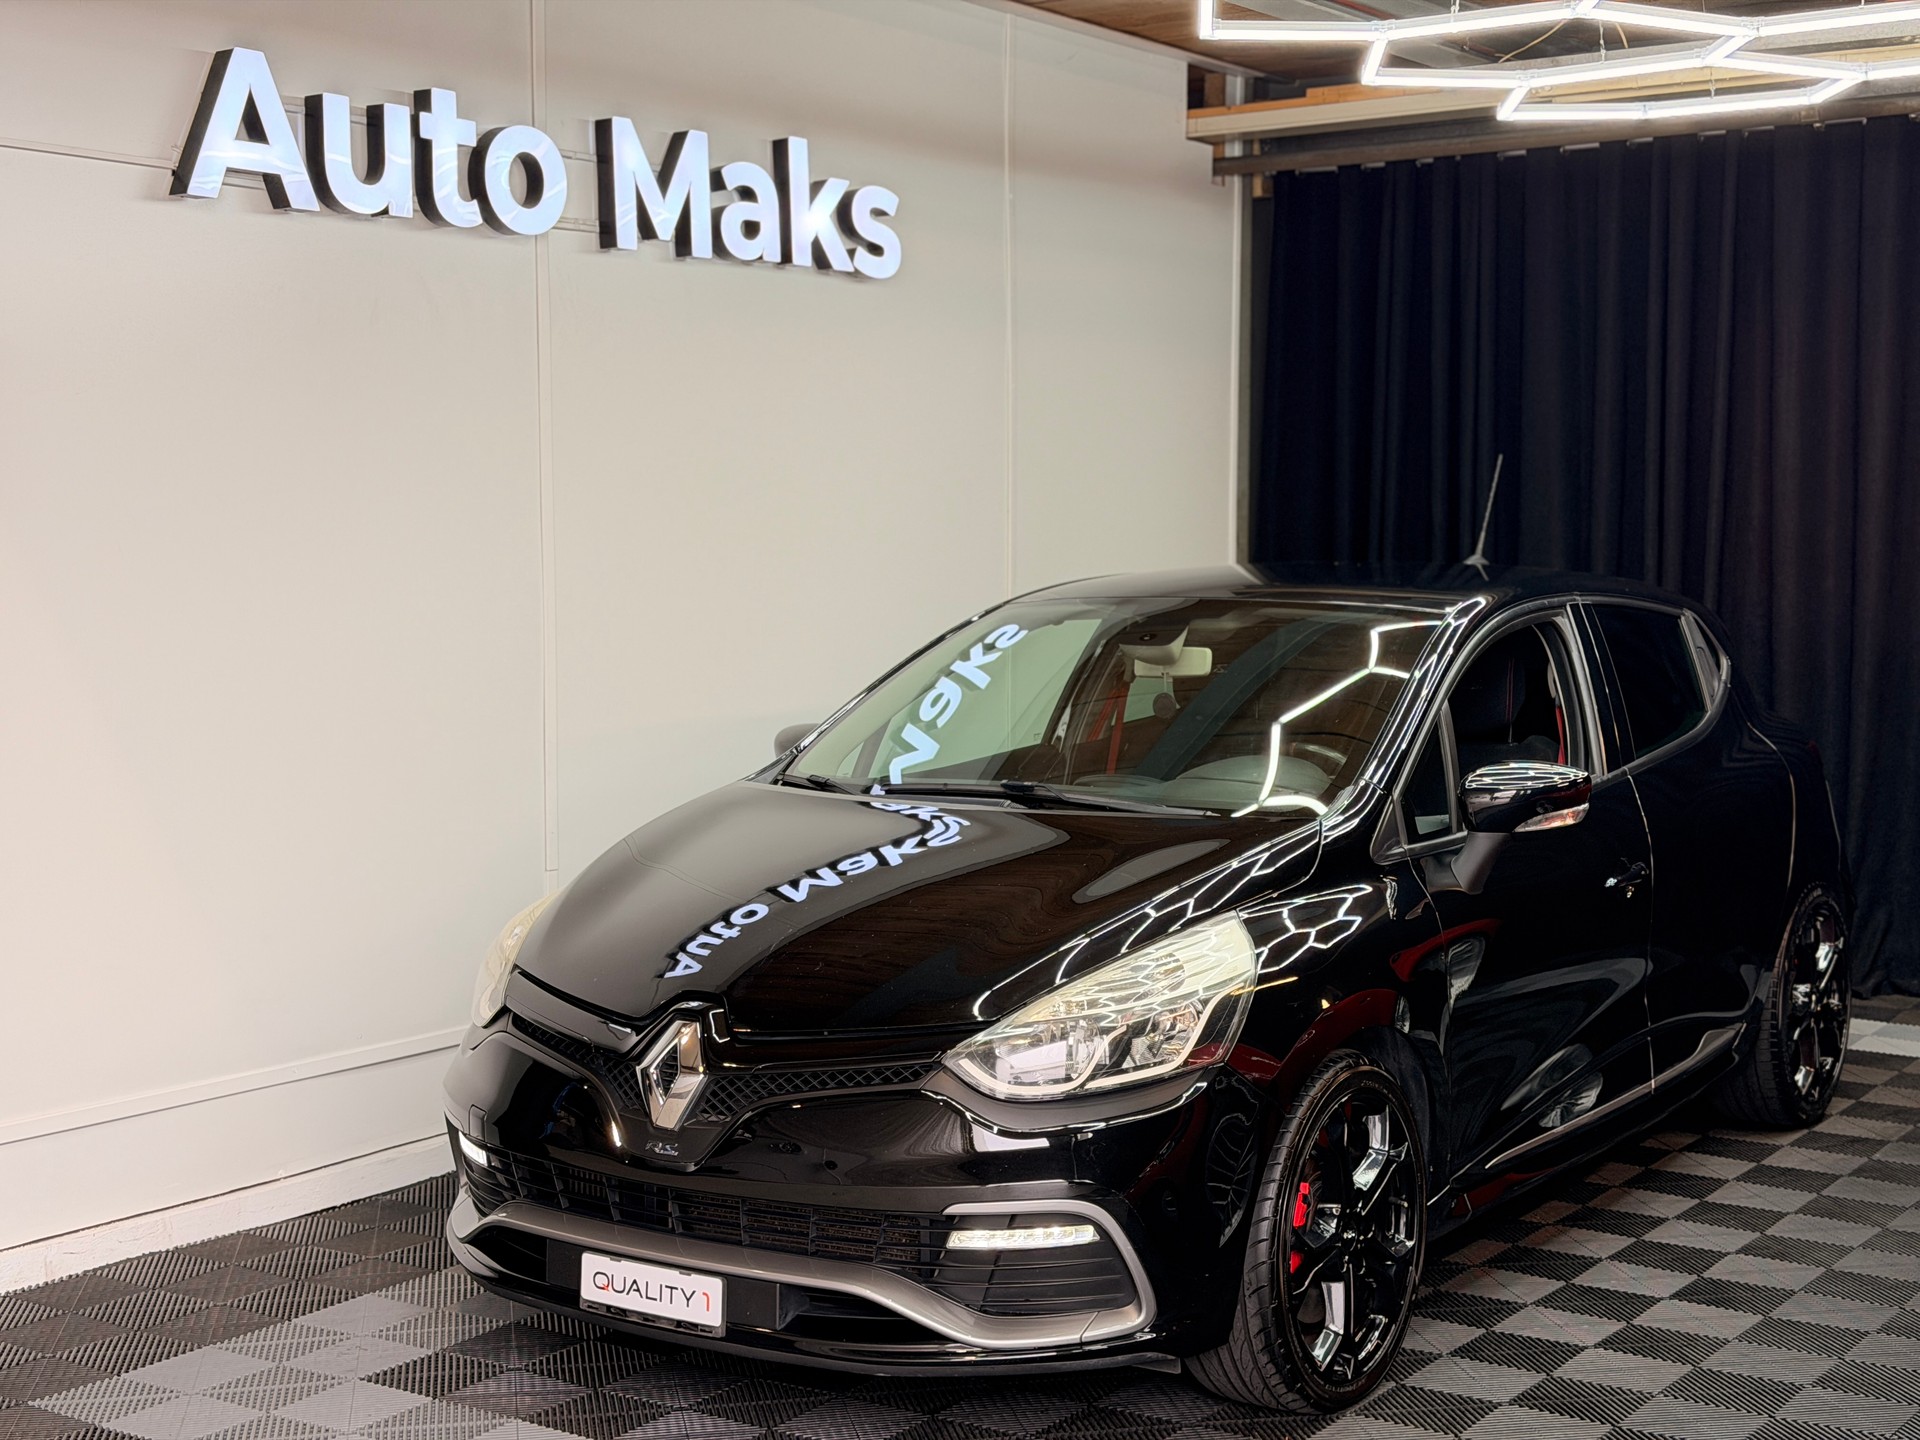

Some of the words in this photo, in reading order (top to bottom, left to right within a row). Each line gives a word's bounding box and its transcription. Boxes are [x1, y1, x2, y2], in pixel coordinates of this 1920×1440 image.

[173, 47, 567, 237] Auto
[596, 116, 903, 280] Maks
[592, 1271, 697, 1308] QUALITY
